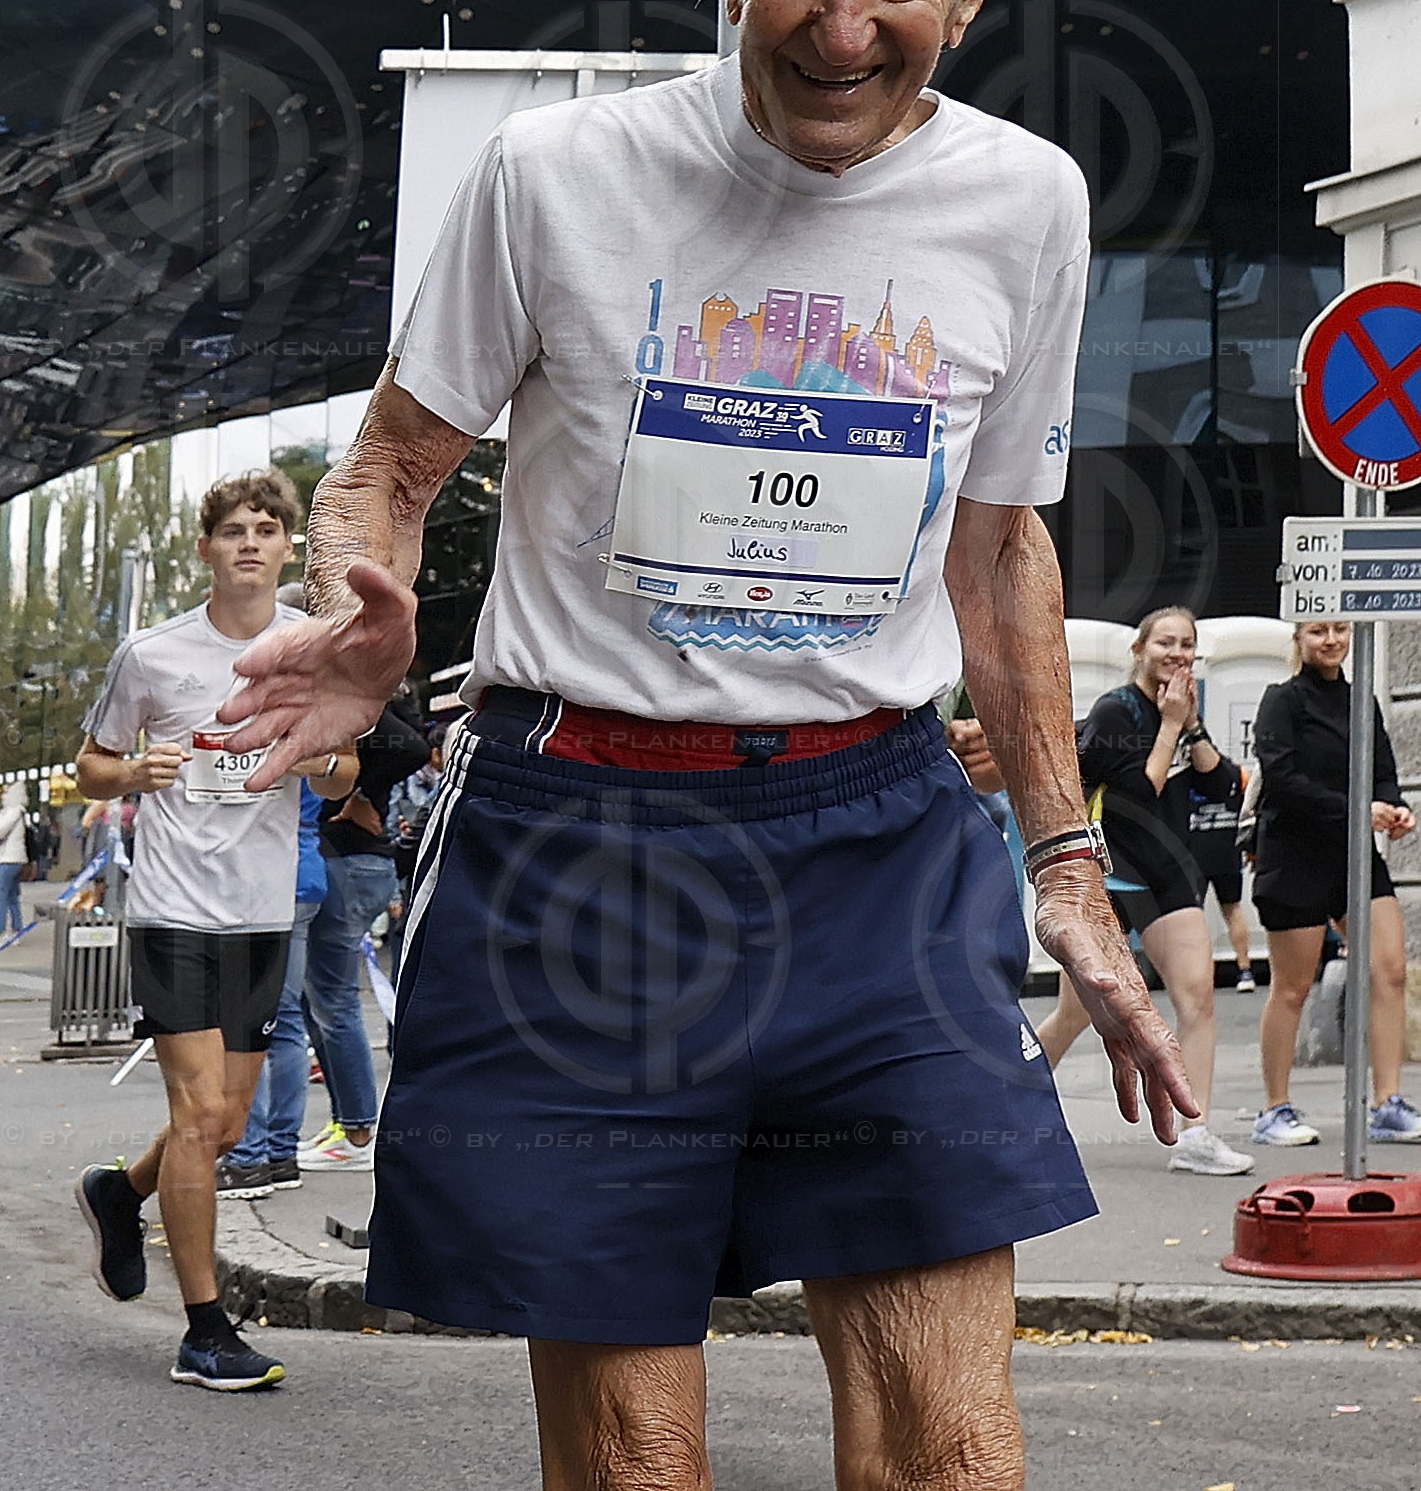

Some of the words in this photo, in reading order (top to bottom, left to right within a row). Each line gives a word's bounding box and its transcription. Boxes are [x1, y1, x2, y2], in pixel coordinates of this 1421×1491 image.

[717, 397, 778, 419] GRAZ
[700, 414, 757, 428] MARATHON
[738, 428, 763, 438] 2023
[849, 429, 904, 446] GRAZ
[1354, 459, 1400, 486] ENDE
[748, 470, 820, 508] 100
[699, 511, 739, 527] Kleine
[742, 515, 788, 533] Zeitung
[791, 519, 848, 535] Marathon
[726, 538, 788, 561] Julius
